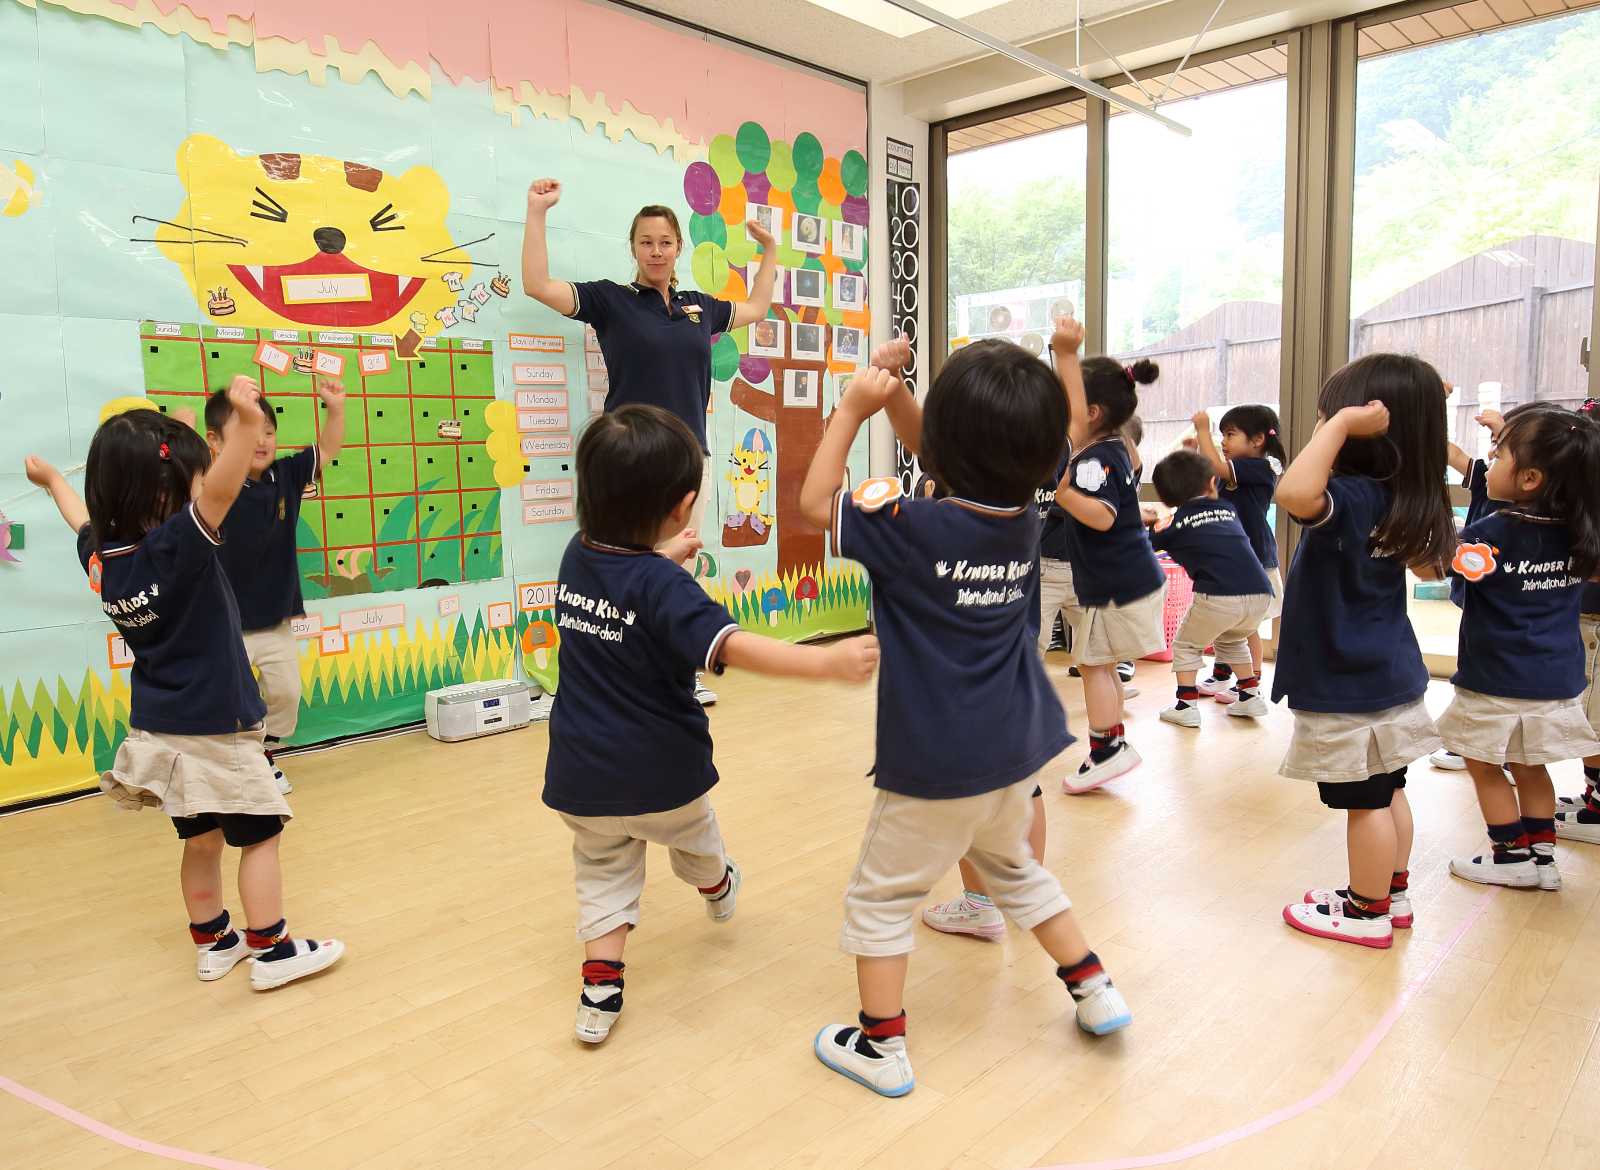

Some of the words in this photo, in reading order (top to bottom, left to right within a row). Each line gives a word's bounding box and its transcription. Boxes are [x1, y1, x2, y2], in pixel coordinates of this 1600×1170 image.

[894, 184, 919, 216] 10
[891, 216, 919, 249] 20
[892, 250, 918, 281] 30
[318, 279, 339, 297] July
[892, 281, 918, 313] 40
[526, 367, 554, 380] Sunday
[526, 394, 558, 407] Monday
[529, 415, 559, 426] Tuesday
[525, 440, 570, 451] Wednesday
[535, 485, 560, 496] Friday
[530, 505, 566, 517] Saturday
[953, 560, 1005, 581] KINDER
[1006, 560, 1031, 581] KIDS
[1518, 560, 1565, 575] KINDER
[1522, 574, 1567, 591] International
[118, 590, 149, 614] KIDS
[558, 583, 596, 613] KNDER
[595, 598, 620, 619] KID
[955, 585, 1006, 607] International
[362, 610, 384, 625] July
